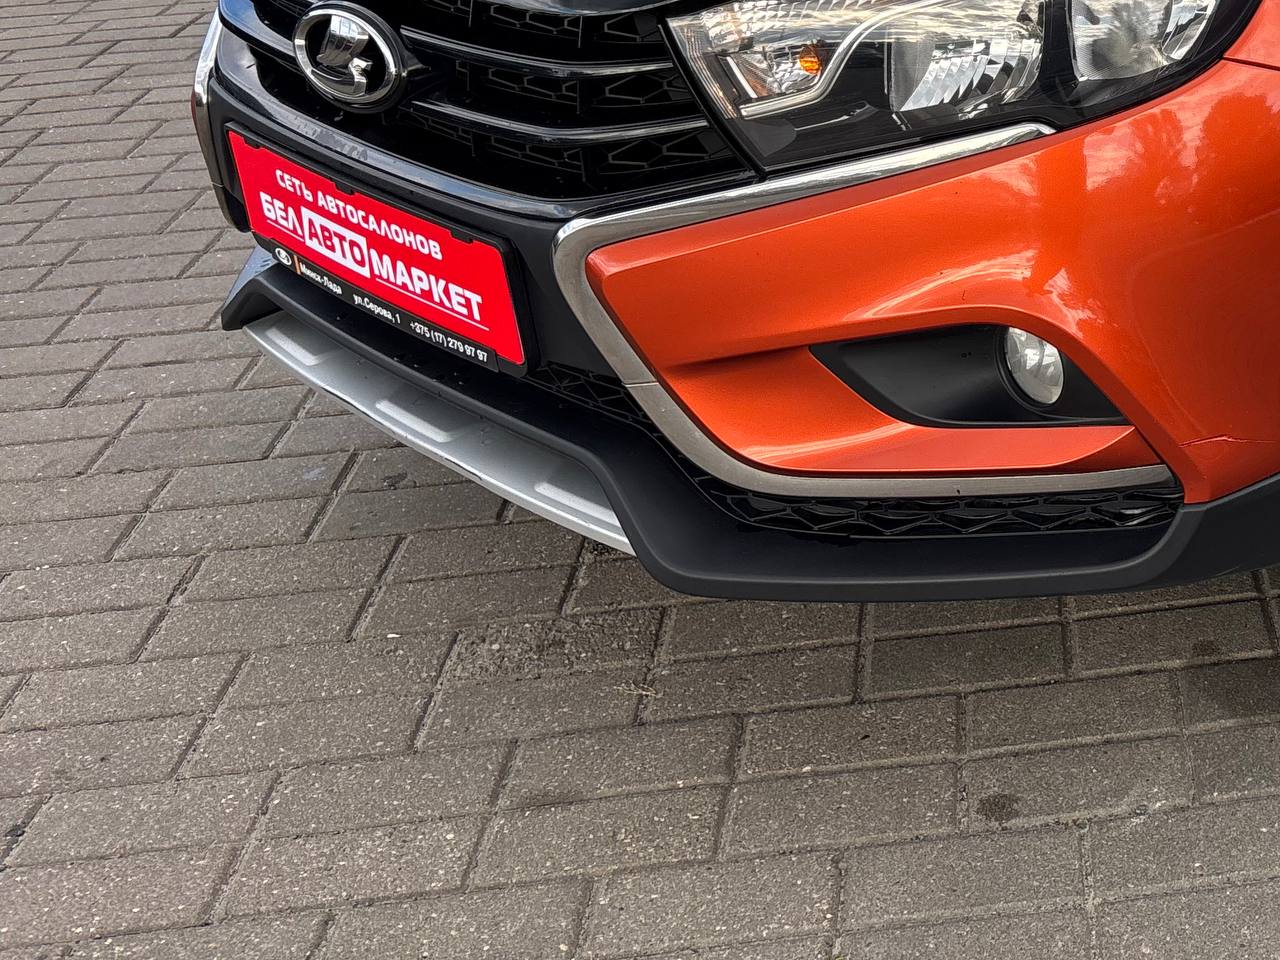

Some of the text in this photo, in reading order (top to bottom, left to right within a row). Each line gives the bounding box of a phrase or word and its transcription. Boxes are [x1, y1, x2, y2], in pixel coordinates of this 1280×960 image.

[275, 169, 443, 260] СЕТЬ АВТОСАЛОНОВ
[410, 321, 430, 338] +375
[431, 329, 447, 347] (17)
[447, 338, 464, 352] 279
[464, 345, 475, 358] 97
[477, 349, 488, 362] 97
